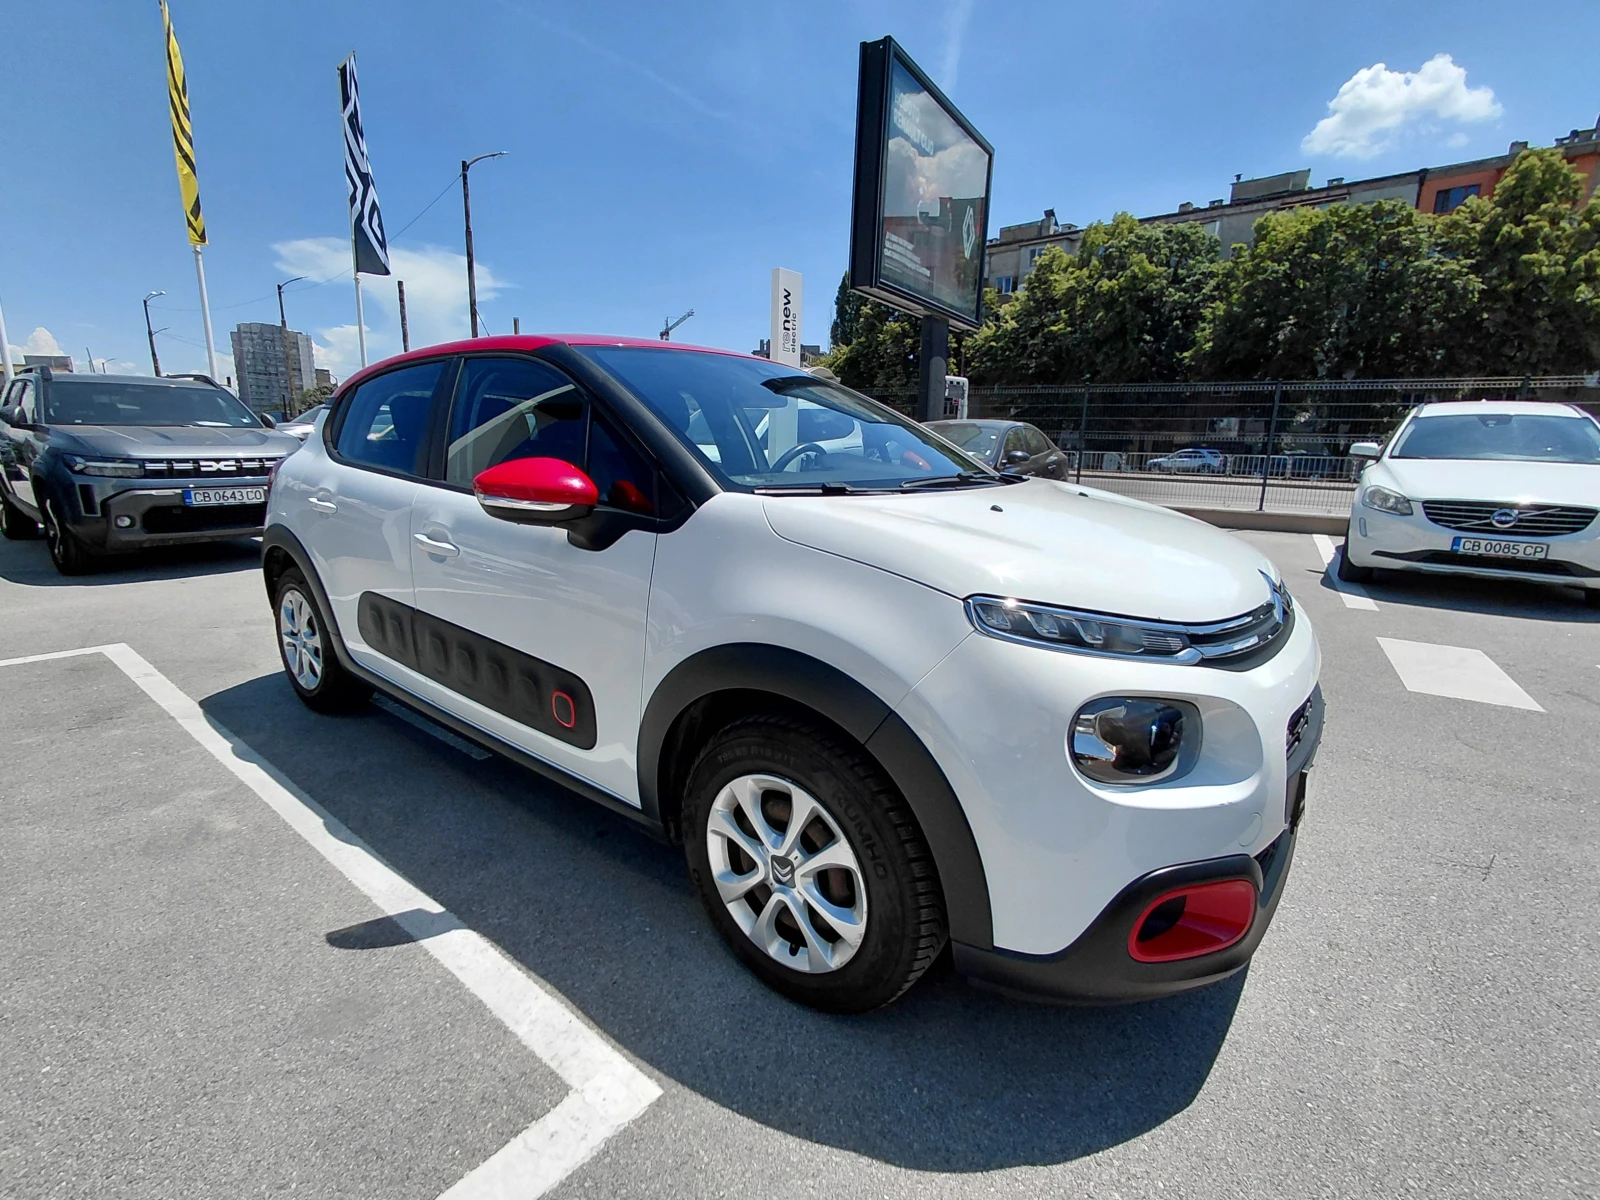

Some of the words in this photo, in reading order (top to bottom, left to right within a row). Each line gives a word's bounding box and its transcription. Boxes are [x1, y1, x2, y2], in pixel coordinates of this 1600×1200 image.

[782, 287, 792, 353] renew
[194, 491, 212, 503] CB
[214, 490, 245, 502] 0643
[1462, 539, 1481, 552] CB
[1484, 541, 1520, 555] 0085
[1523, 544, 1544, 557] CP
